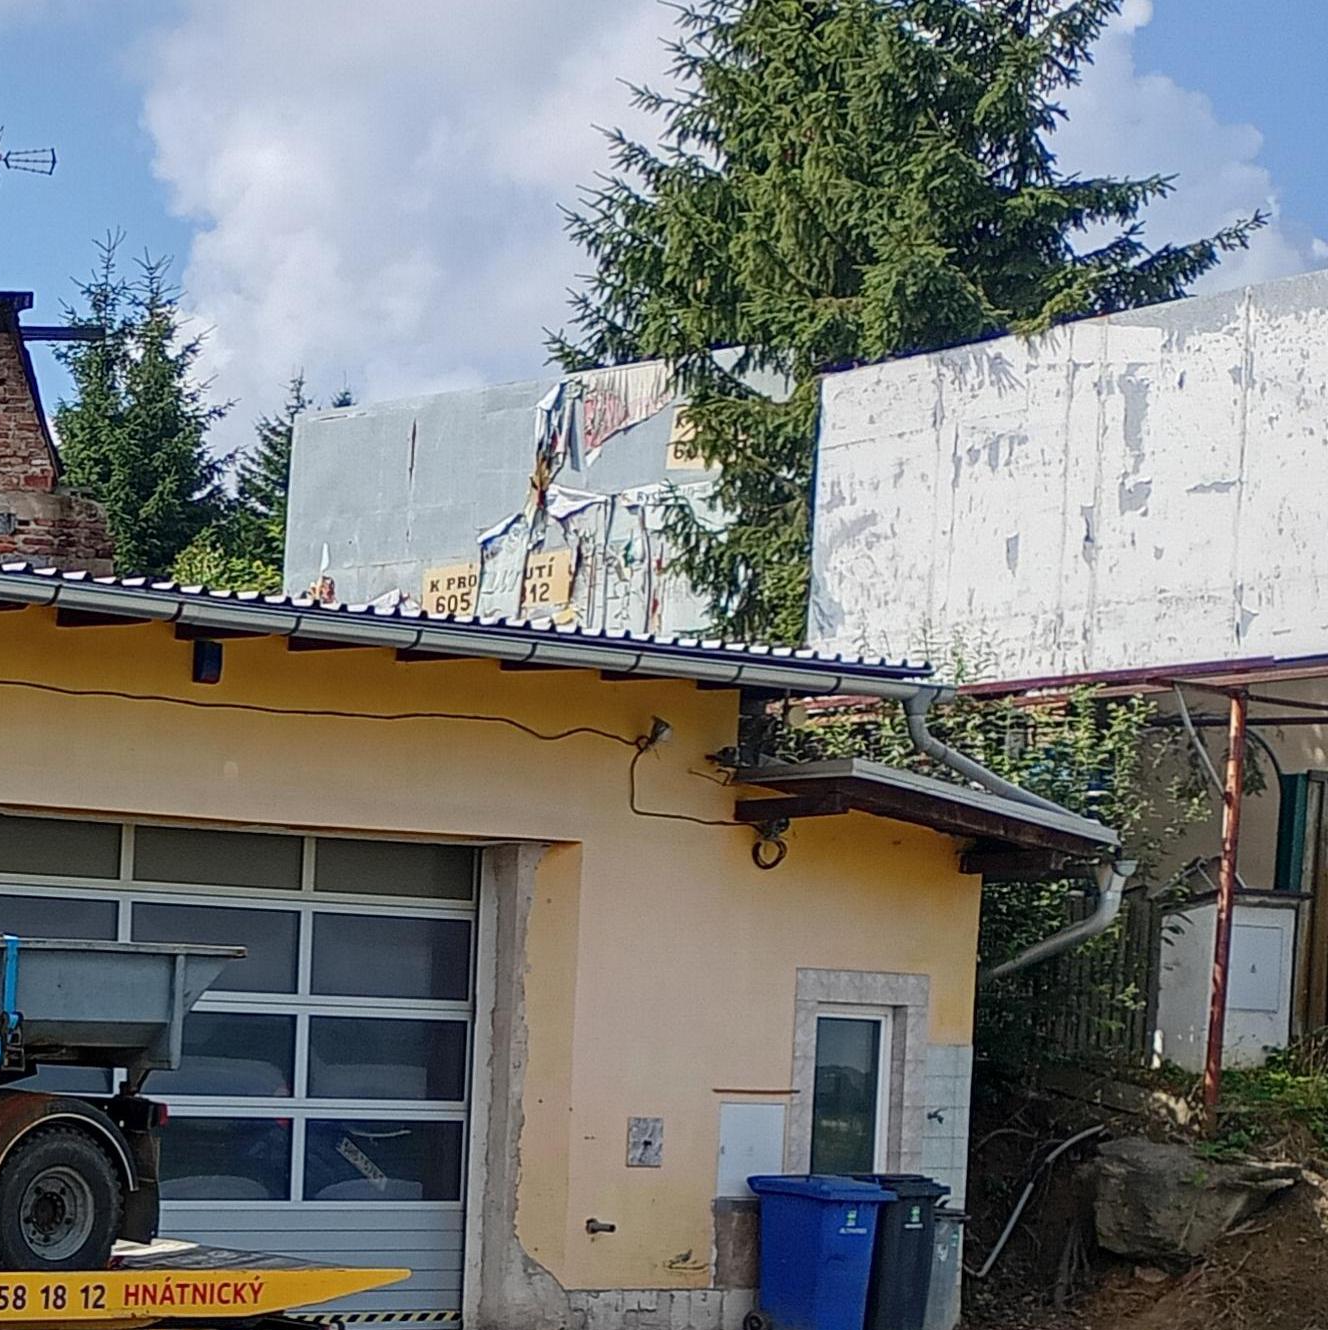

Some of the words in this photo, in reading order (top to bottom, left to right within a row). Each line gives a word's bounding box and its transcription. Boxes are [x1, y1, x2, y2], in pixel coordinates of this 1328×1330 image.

[435, 591, 472, 613] 605
[40, 1285, 67, 1310] 18
[81, 1284, 107, 1309] 12
[123, 1275, 264, 1307] HNÁTNICKÝ
